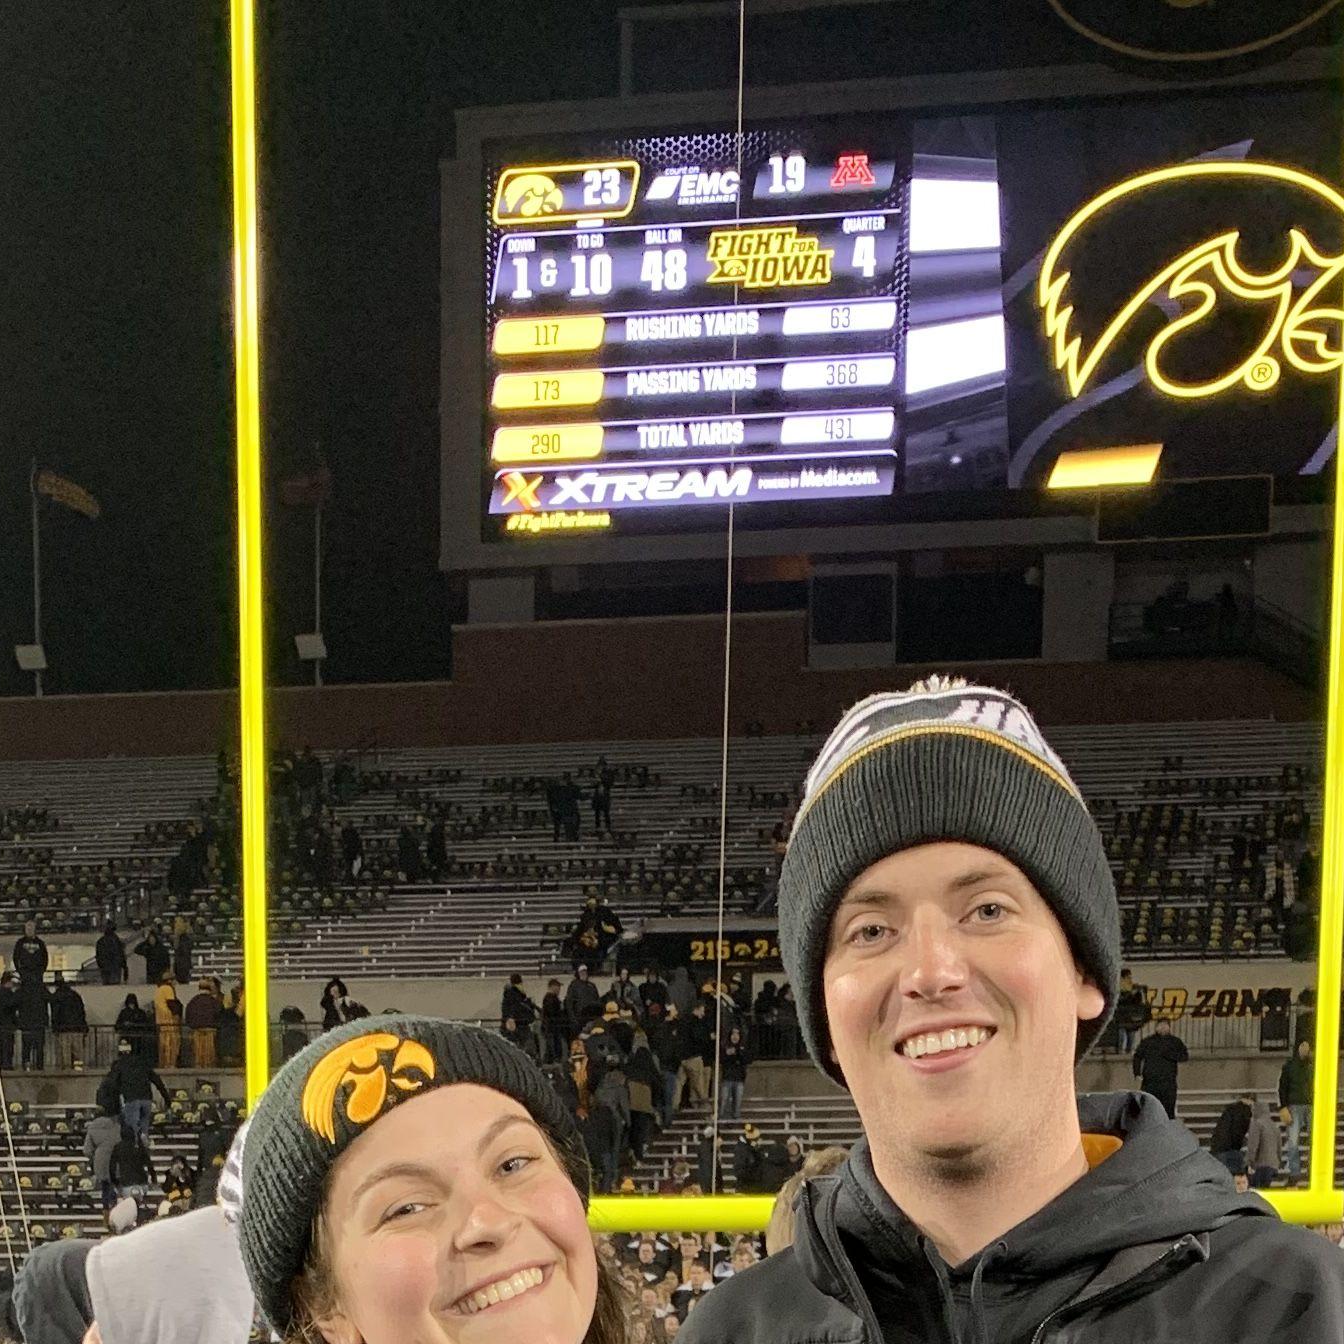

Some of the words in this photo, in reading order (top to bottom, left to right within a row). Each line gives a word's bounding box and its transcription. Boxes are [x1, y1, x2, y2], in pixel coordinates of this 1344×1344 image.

[584, 169, 621, 206] 23
[678, 171, 739, 196] EMC
[768, 155, 806, 193] 19
[842, 217, 886, 234] QUARTER
[508, 238, 536, 253] DOWN
[710, 232, 792, 258] FIGHT
[790, 241, 815, 253] FOR
[852, 235, 876, 277] 4
[512, 257, 532, 299] 1
[570, 254, 612, 297] 10
[640, 249, 687, 291] 48
[750, 254, 827, 284] IOWA
[625, 316, 702, 341] RUSHING
[703, 311, 759, 335] YARDS
[831, 307, 851, 329] 63
[534, 325, 560, 346] 117
[627, 371, 700, 396] PASSING
[701, 366, 757, 391] YARDS
[826, 363, 858, 386] 368
[533, 380, 560, 402] 173
[637, 424, 688, 449] TOTAL
[689, 421, 745, 446] YARDS
[825, 417, 854, 440] 431
[531, 434, 561, 455] 290
[548, 468, 753, 504] XTREAM
